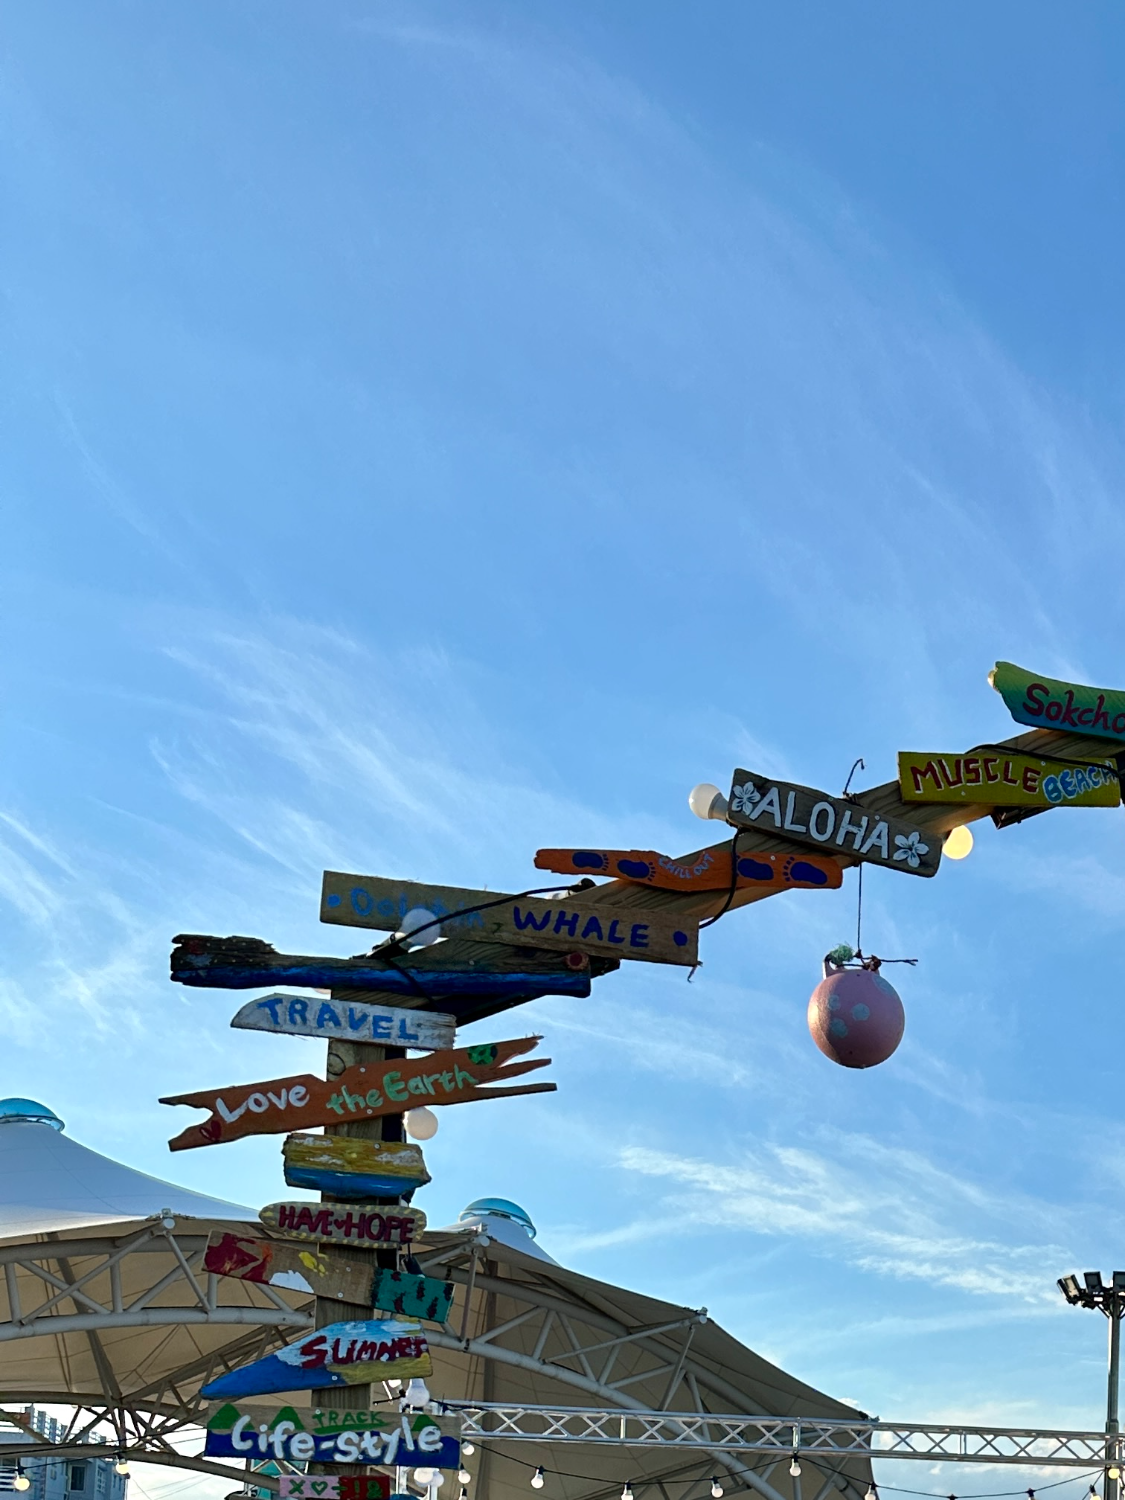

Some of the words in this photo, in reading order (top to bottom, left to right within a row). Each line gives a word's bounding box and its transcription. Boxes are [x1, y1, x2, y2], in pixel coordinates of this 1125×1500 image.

[910, 758, 1042, 795] MUSCLE
[1042, 759, 1118, 804] BEACH
[749, 787, 890, 860] ALOHA
[512, 906, 650, 948] WHALE
[256, 998, 420, 1042] TRAVEL
[216, 1082, 311, 1124] Love
[326, 1086, 384, 1116] the
[384, 1063, 478, 1102] Earth
[278, 1206, 335, 1236] HAVE
[344, 1211, 416, 1243] HOPE
